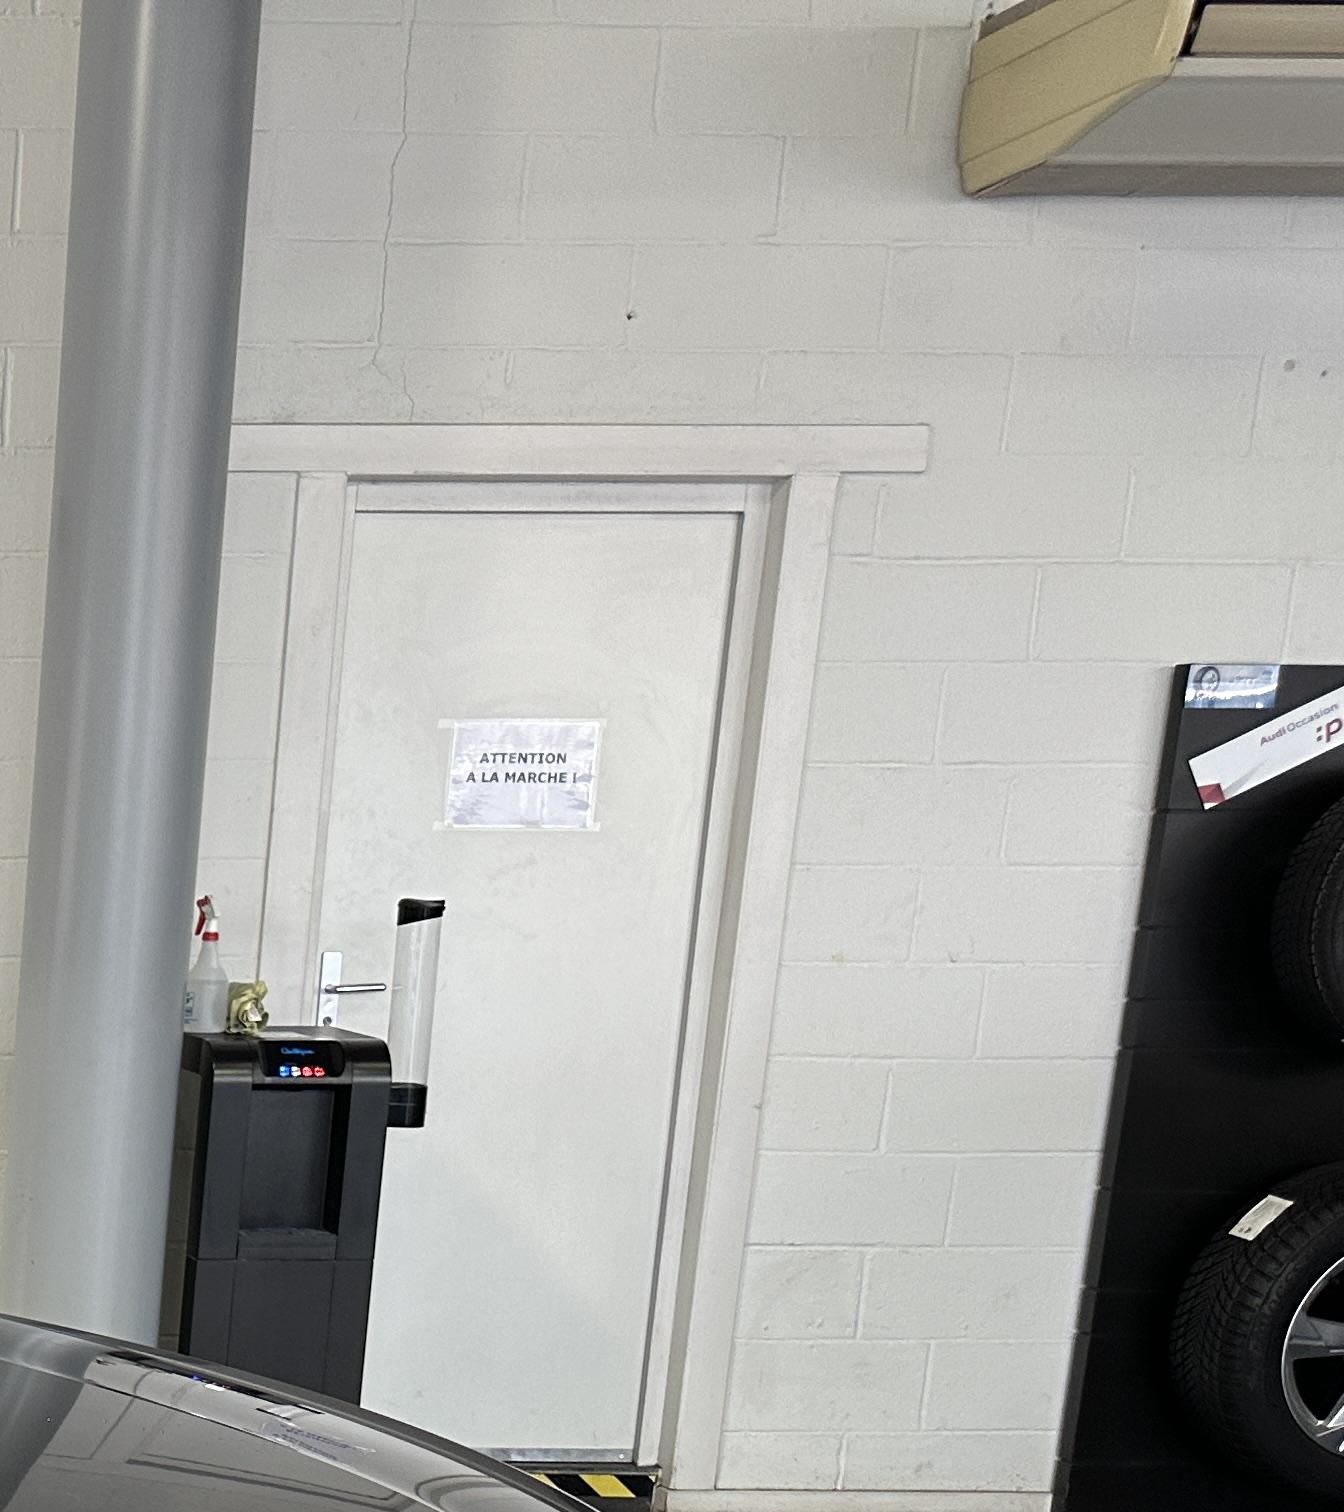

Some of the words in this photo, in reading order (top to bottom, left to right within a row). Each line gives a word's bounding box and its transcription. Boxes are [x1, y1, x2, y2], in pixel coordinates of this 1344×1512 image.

[1261, 727, 1286, 746] Audi
[1287, 703, 1340, 732] Occasion
[479, 752, 567, 765] ATTENTION
[466, 771, 477, 784] A
[481, 771, 499, 784] LA
[504, 771, 568, 784] MARCHE
